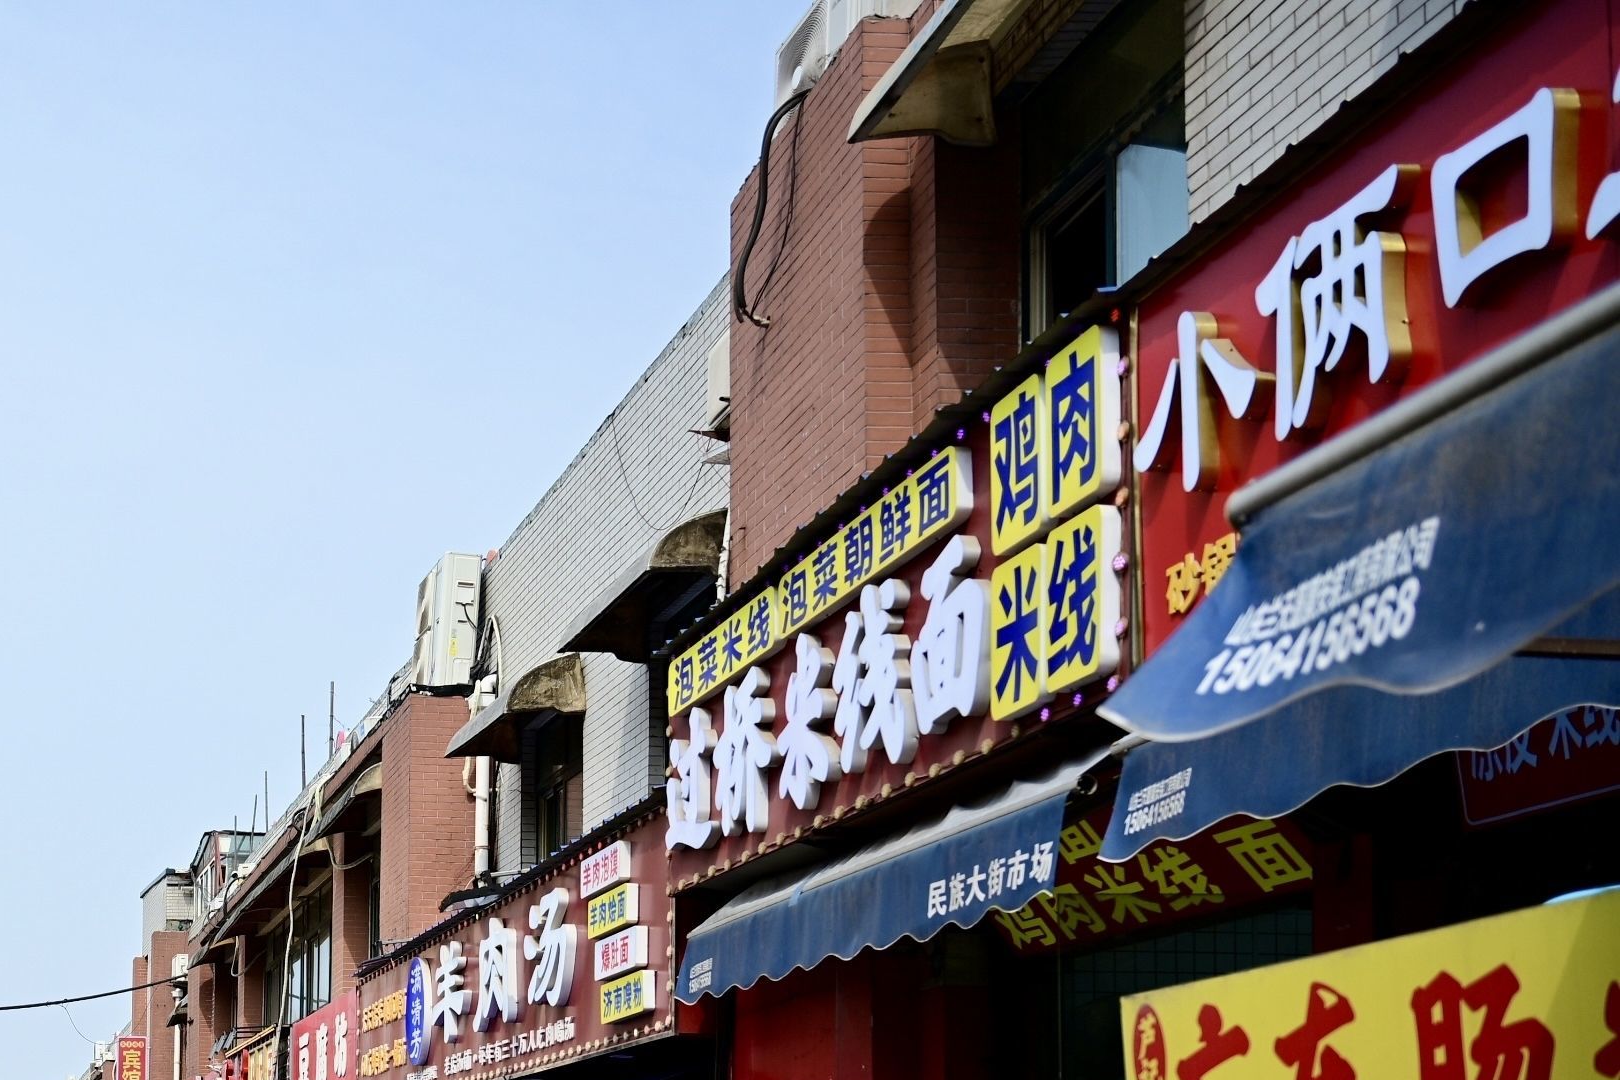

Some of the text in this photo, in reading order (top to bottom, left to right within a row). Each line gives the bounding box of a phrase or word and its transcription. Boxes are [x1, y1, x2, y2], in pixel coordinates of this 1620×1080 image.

[1133, 65, 1620, 492] 小俩口
[995, 351, 1096, 544] 鸡肉
[782, 455, 952, 633] 泡菜朝鲜面
[996, 524, 1096, 701] 米线
[666, 534, 991, 850] 过桥米线面
[674, 597, 772, 702] 泡菜米线
[582, 848, 619, 893] 羊肉泡馍
[927, 840, 1055, 918] 民族大街市场
[431, 887, 577, 1044] 羊肉汤
